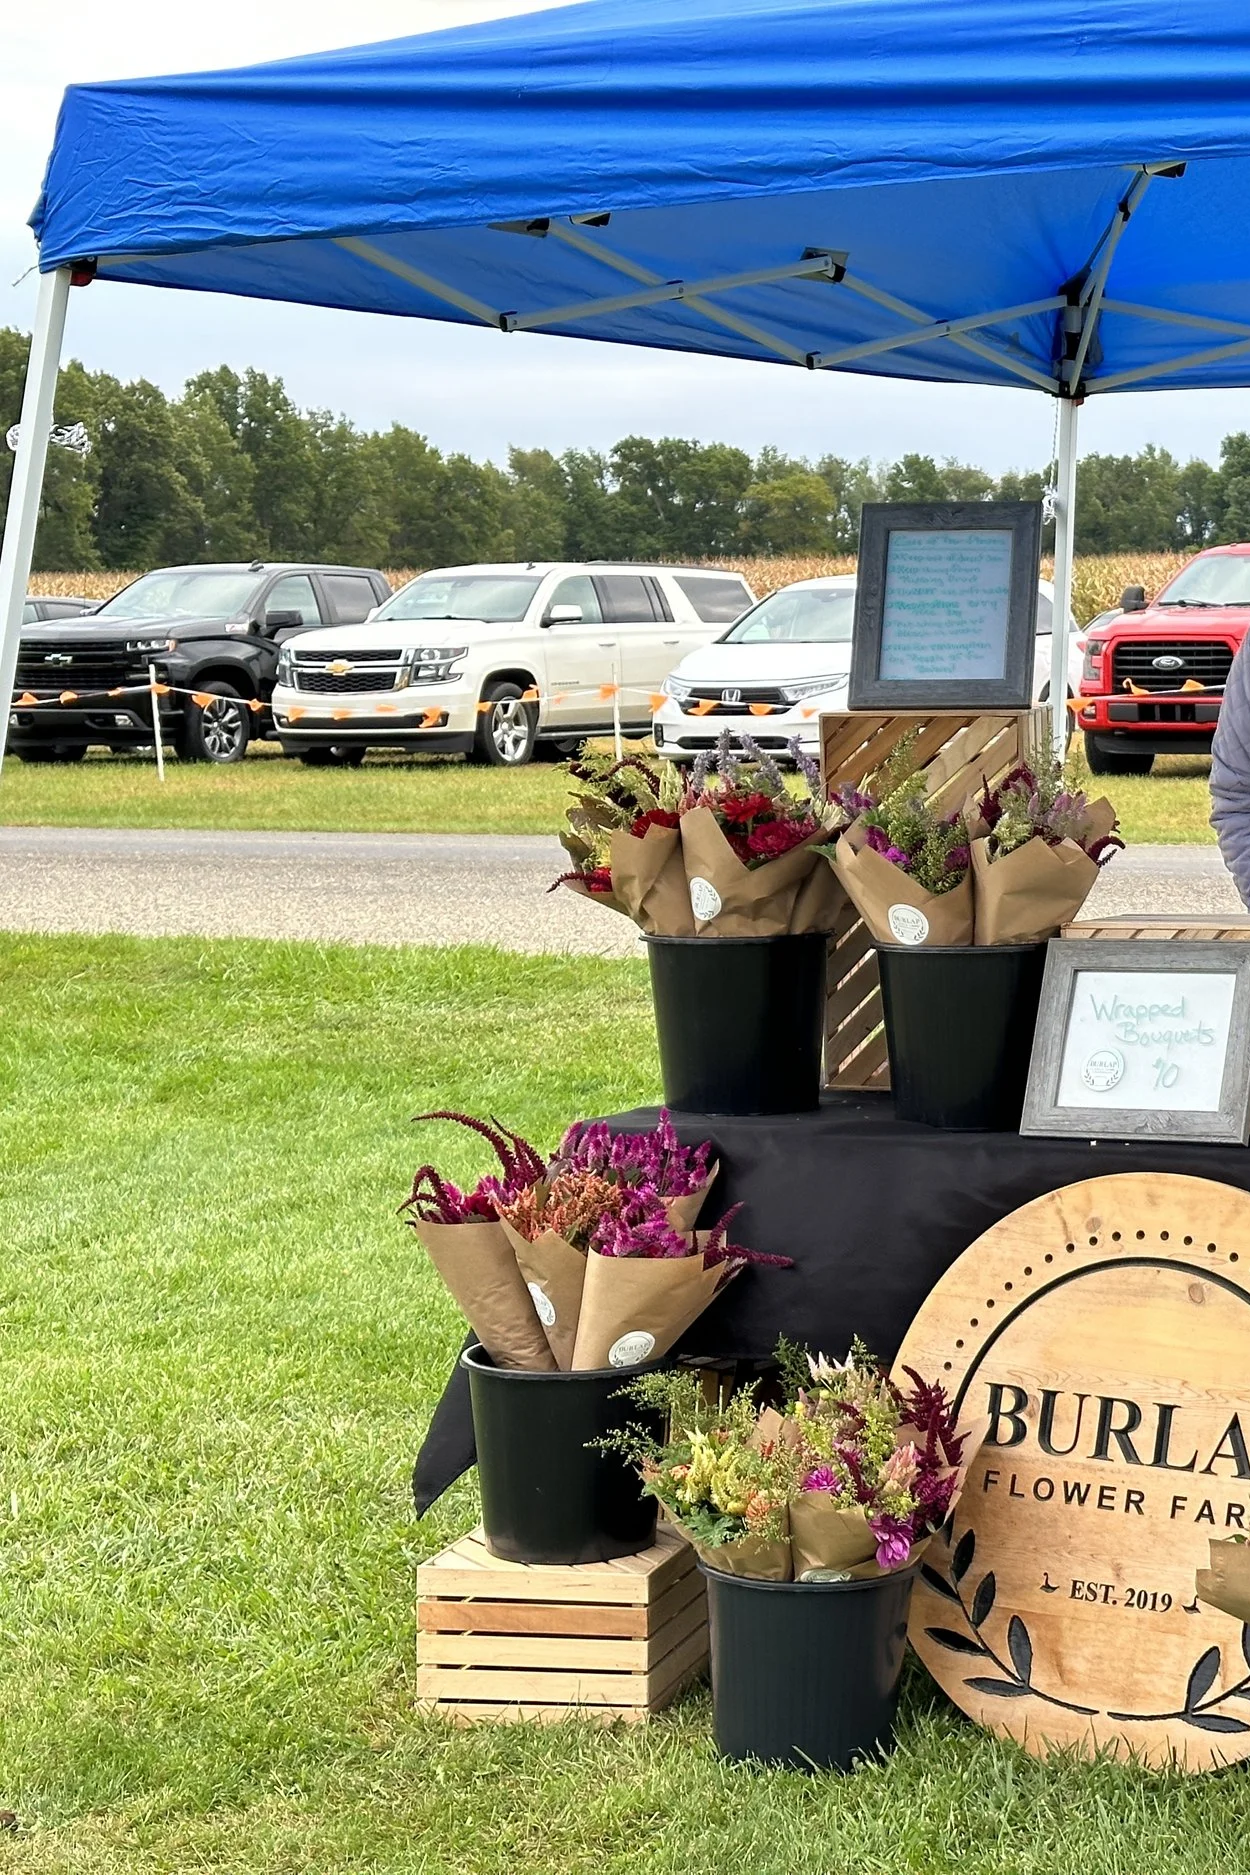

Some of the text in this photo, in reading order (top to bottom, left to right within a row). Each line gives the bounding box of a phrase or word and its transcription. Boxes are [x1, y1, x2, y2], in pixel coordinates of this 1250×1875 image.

[1089, 993, 1186, 1025] Wrapped
[1114, 1020, 1215, 1052] Bouquets
[982, 1469, 1250, 1530] FLOWER FAR
[1069, 1579, 1173, 1613] EST. 2019
